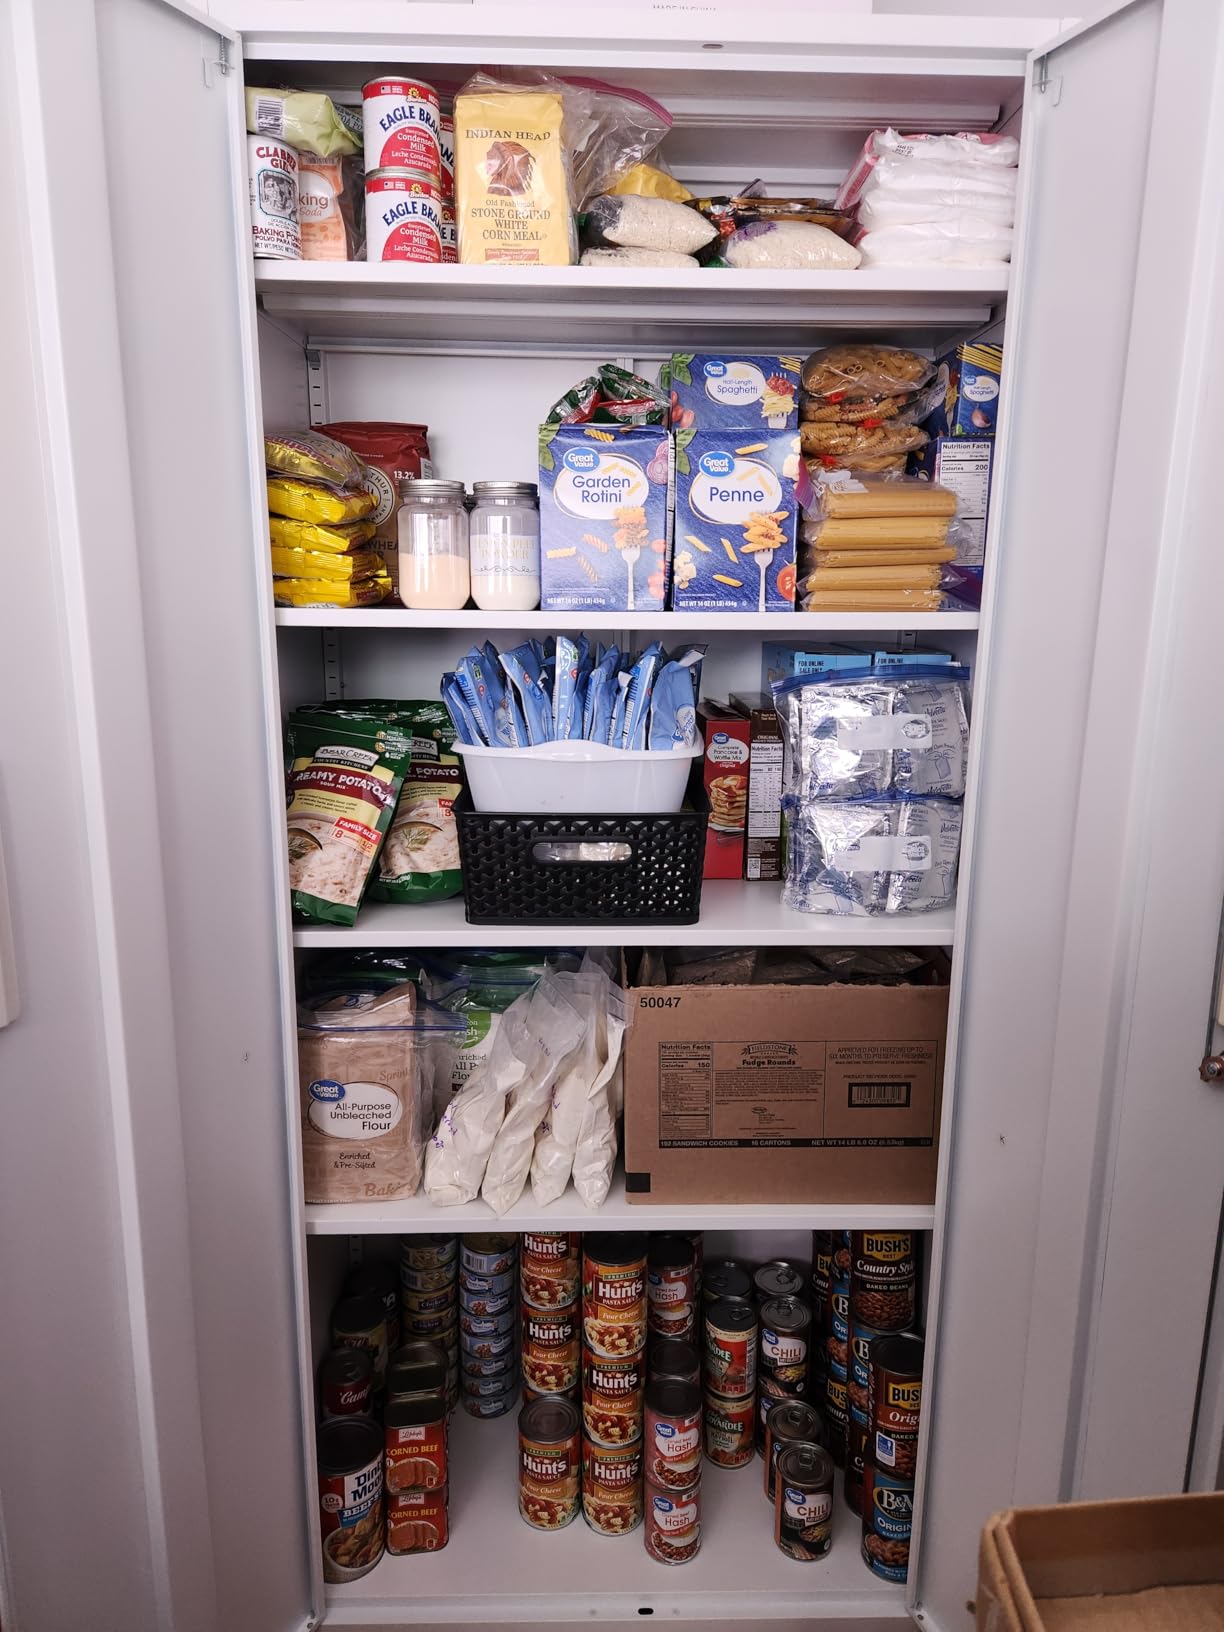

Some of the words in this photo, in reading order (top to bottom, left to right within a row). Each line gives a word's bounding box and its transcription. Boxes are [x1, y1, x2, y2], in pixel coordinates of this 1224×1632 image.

[380, 105, 416, 132] EAGLE
[418, 108, 440, 140] BRAN
[397, 132, 434, 148] Condensed
[466, 129, 512, 139] INDIAN
[516, 131, 551, 141] HEAD
[410, 142, 427, 152] Milk
[300, 207, 322, 216] Soda
[382, 201, 418, 226] EAGLE
[422, 203, 441, 232] BRAN
[471, 208, 505, 218] STONE
[507, 209, 550, 220] GROUND
[494, 219, 528, 230] WHITE
[252, 226, 284, 238] BAKING
[400, 228, 437, 242] Condensed
[482, 230, 512, 240] CORN
[514, 230, 542, 240] MEAL
[276, 238, 290, 246] PARA
[412, 237, 428, 246] Milk
[717, 385, 758, 396] Spaghetti
[568, 453, 594, 462] Great
[703, 458, 729, 466] Great
[574, 460, 596, 468] Value
[710, 464, 731, 472] Value
[393, 470, 416, 480] 13.2%
[572, 474, 631, 490] Garden
[582, 489, 622, 504] Rotini
[710, 486, 764, 503] Penne
[416, 767, 460, 777] POTATO
[338, 774, 383, 796] POTATO
[334, 830, 344, 839] 8
[338, 820, 364, 832] FAMILY
[362, 830, 378, 841] SIZE
[640, 996, 681, 1008] 50047
[313, 1084, 339, 1094] Great
[334, 1102, 392, 1112] All-Purpose
[330, 1111, 392, 1120] Unbleached
[362, 1122, 392, 1131] Flour
[338, 1152, 371, 1160] Enriched
[340, 1160, 376, 1169] Pre-Sifted
[524, 1234, 567, 1254] Hunt's
[867, 1238, 910, 1252] BUSH'S
[527, 1250, 542, 1259] PASTA
[527, 1263, 540, 1272] Four
[540, 1266, 562, 1274] Cheese
[856, 1260, 897, 1276] Country
[600, 1279, 643, 1299] Hunt's
[656, 1292, 678, 1300] Hash
[602, 1312, 618, 1320] Four
[529, 1322, 572, 1341] Hunt's
[532, 1338, 548, 1346] PASTA
[533, 1350, 546, 1358] Four
[546, 1350, 568, 1359] Cheese
[592, 1369, 638, 1389] Hunt's
[596, 1386, 612, 1394] PASTA
[596, 1400, 611, 1409] Four
[612, 1400, 633, 1409] Cheese
[386, 1446, 420, 1457] CORNED
[420, 1444, 438, 1453] BEEF
[668, 1442, 692, 1452] Hash
[523, 1454, 567, 1474] Hunt's
[526, 1470, 542, 1479] PASTA
[594, 1462, 638, 1480] Hunt's
[598, 1478, 614, 1486] PASTA
[526, 1482, 540, 1492] Four
[540, 1486, 562, 1494] Cheese
[598, 1490, 614, 1500] Four
[420, 1508, 438, 1516] BEEF
[665, 1516, 690, 1527] Hash
